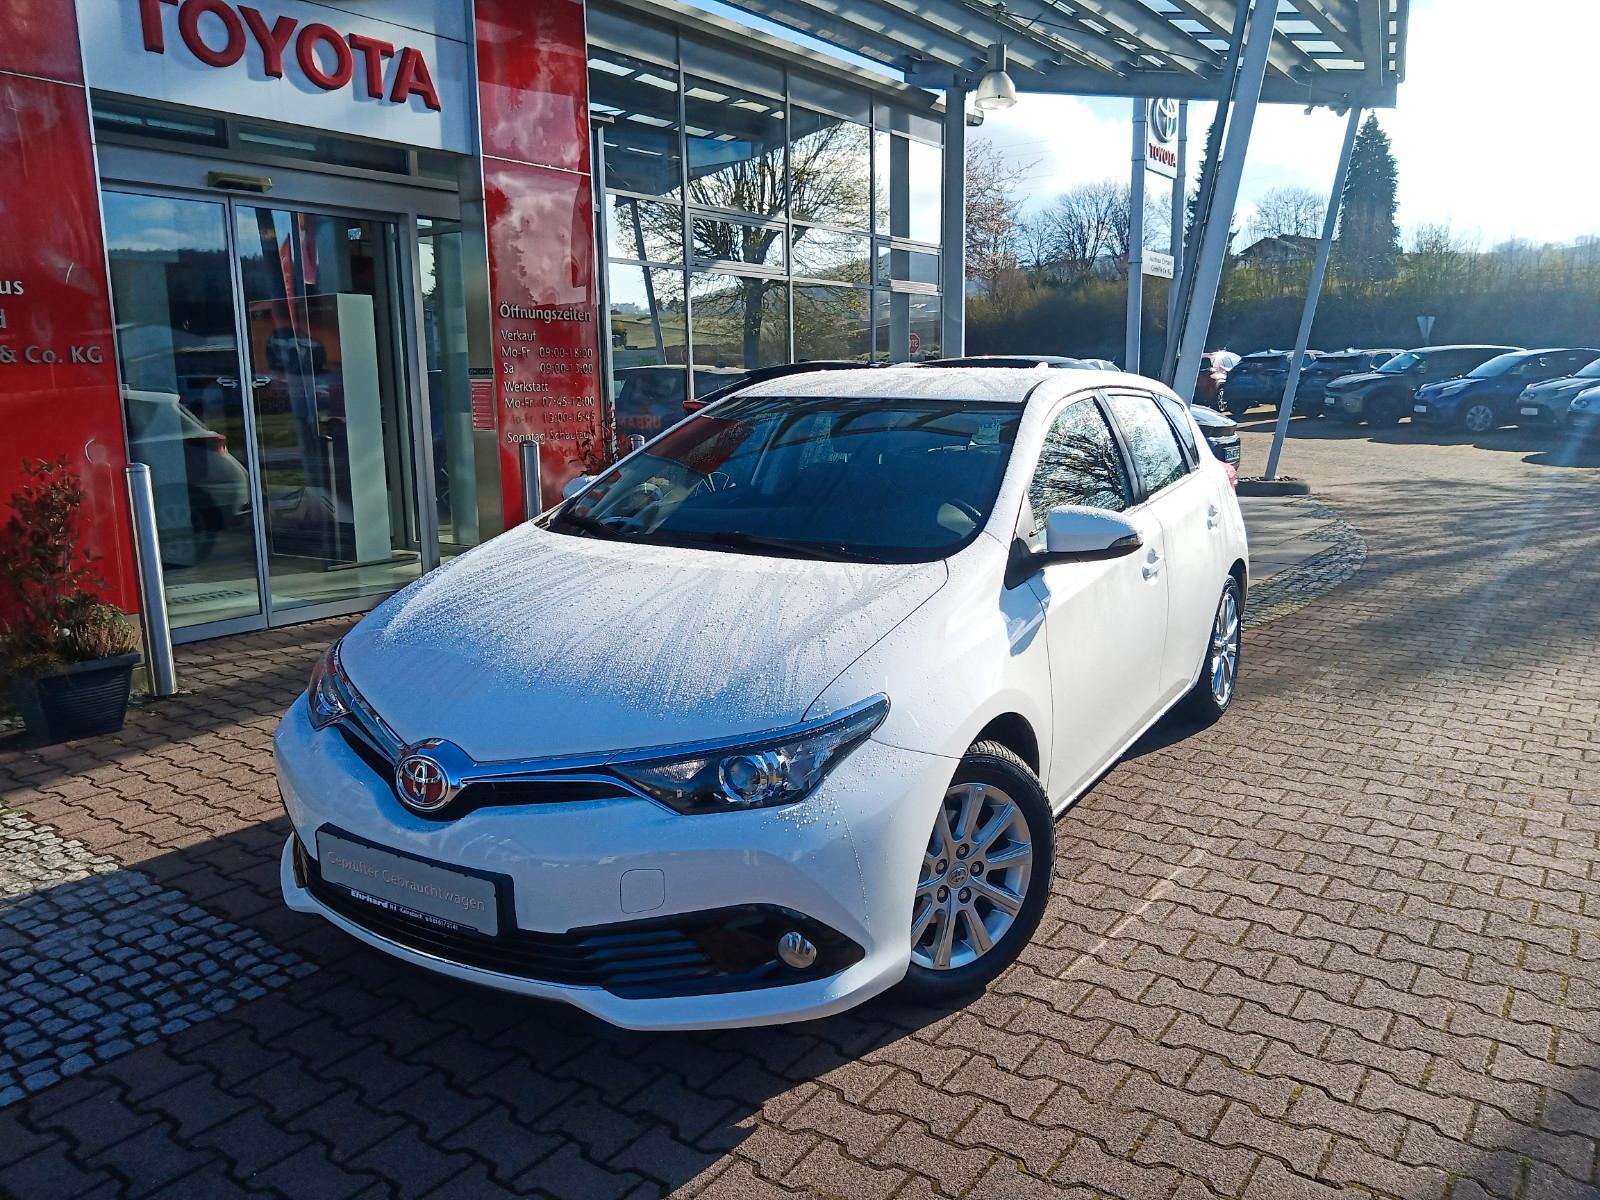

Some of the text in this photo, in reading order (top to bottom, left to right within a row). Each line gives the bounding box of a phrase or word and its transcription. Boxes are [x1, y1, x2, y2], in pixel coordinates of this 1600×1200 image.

[138, 0, 442, 113] TOYOTA
[1148, 142, 1177, 168] TOYOTA
[499, 301, 592, 324] Öffnungszeiten
[501, 329, 537, 342] Verkauf
[25, 345, 63, 363] Co.
[71, 345, 104, 364] KG
[501, 346, 531, 357] Mo-Fr
[503, 362, 514, 374] Sa
[503, 381, 549, 392] Werkstatt
[505, 397, 533, 408] Mo-Fr
[382, 868, 486, 911] Gebrauchtwagen
